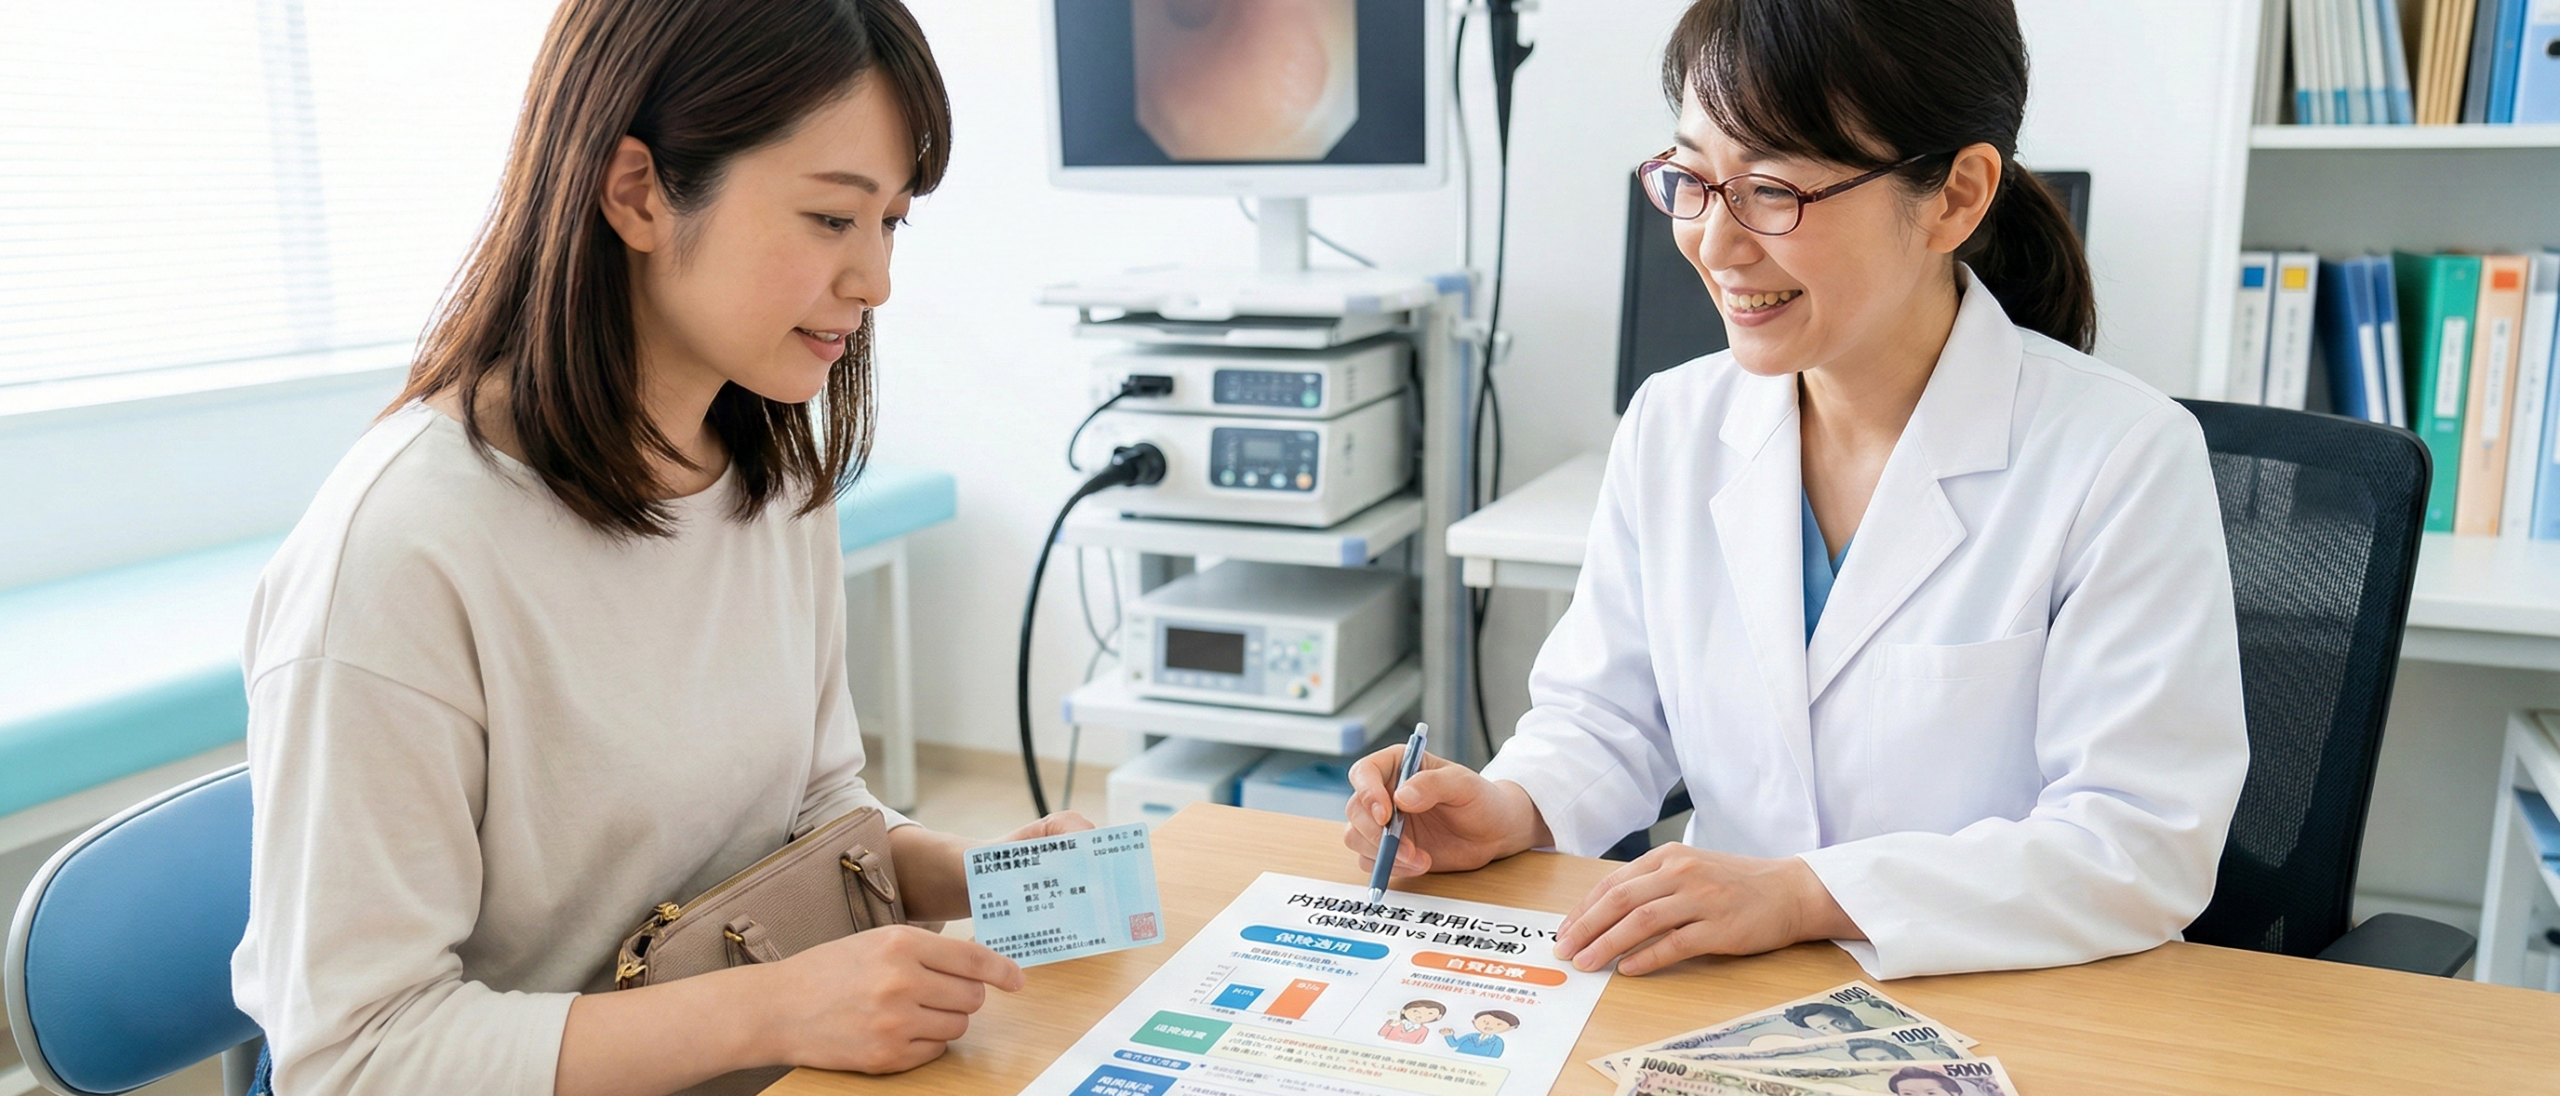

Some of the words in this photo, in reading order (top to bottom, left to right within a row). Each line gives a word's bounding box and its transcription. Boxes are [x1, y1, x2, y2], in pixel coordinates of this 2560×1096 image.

[1406, 929, 1427, 939] vs
[1830, 986, 1870, 1004] 1000
[1891, 1026, 1940, 1044] 1000
[1640, 1057, 1687, 1076] 10000
[1943, 1062, 1993, 1078] 5000
